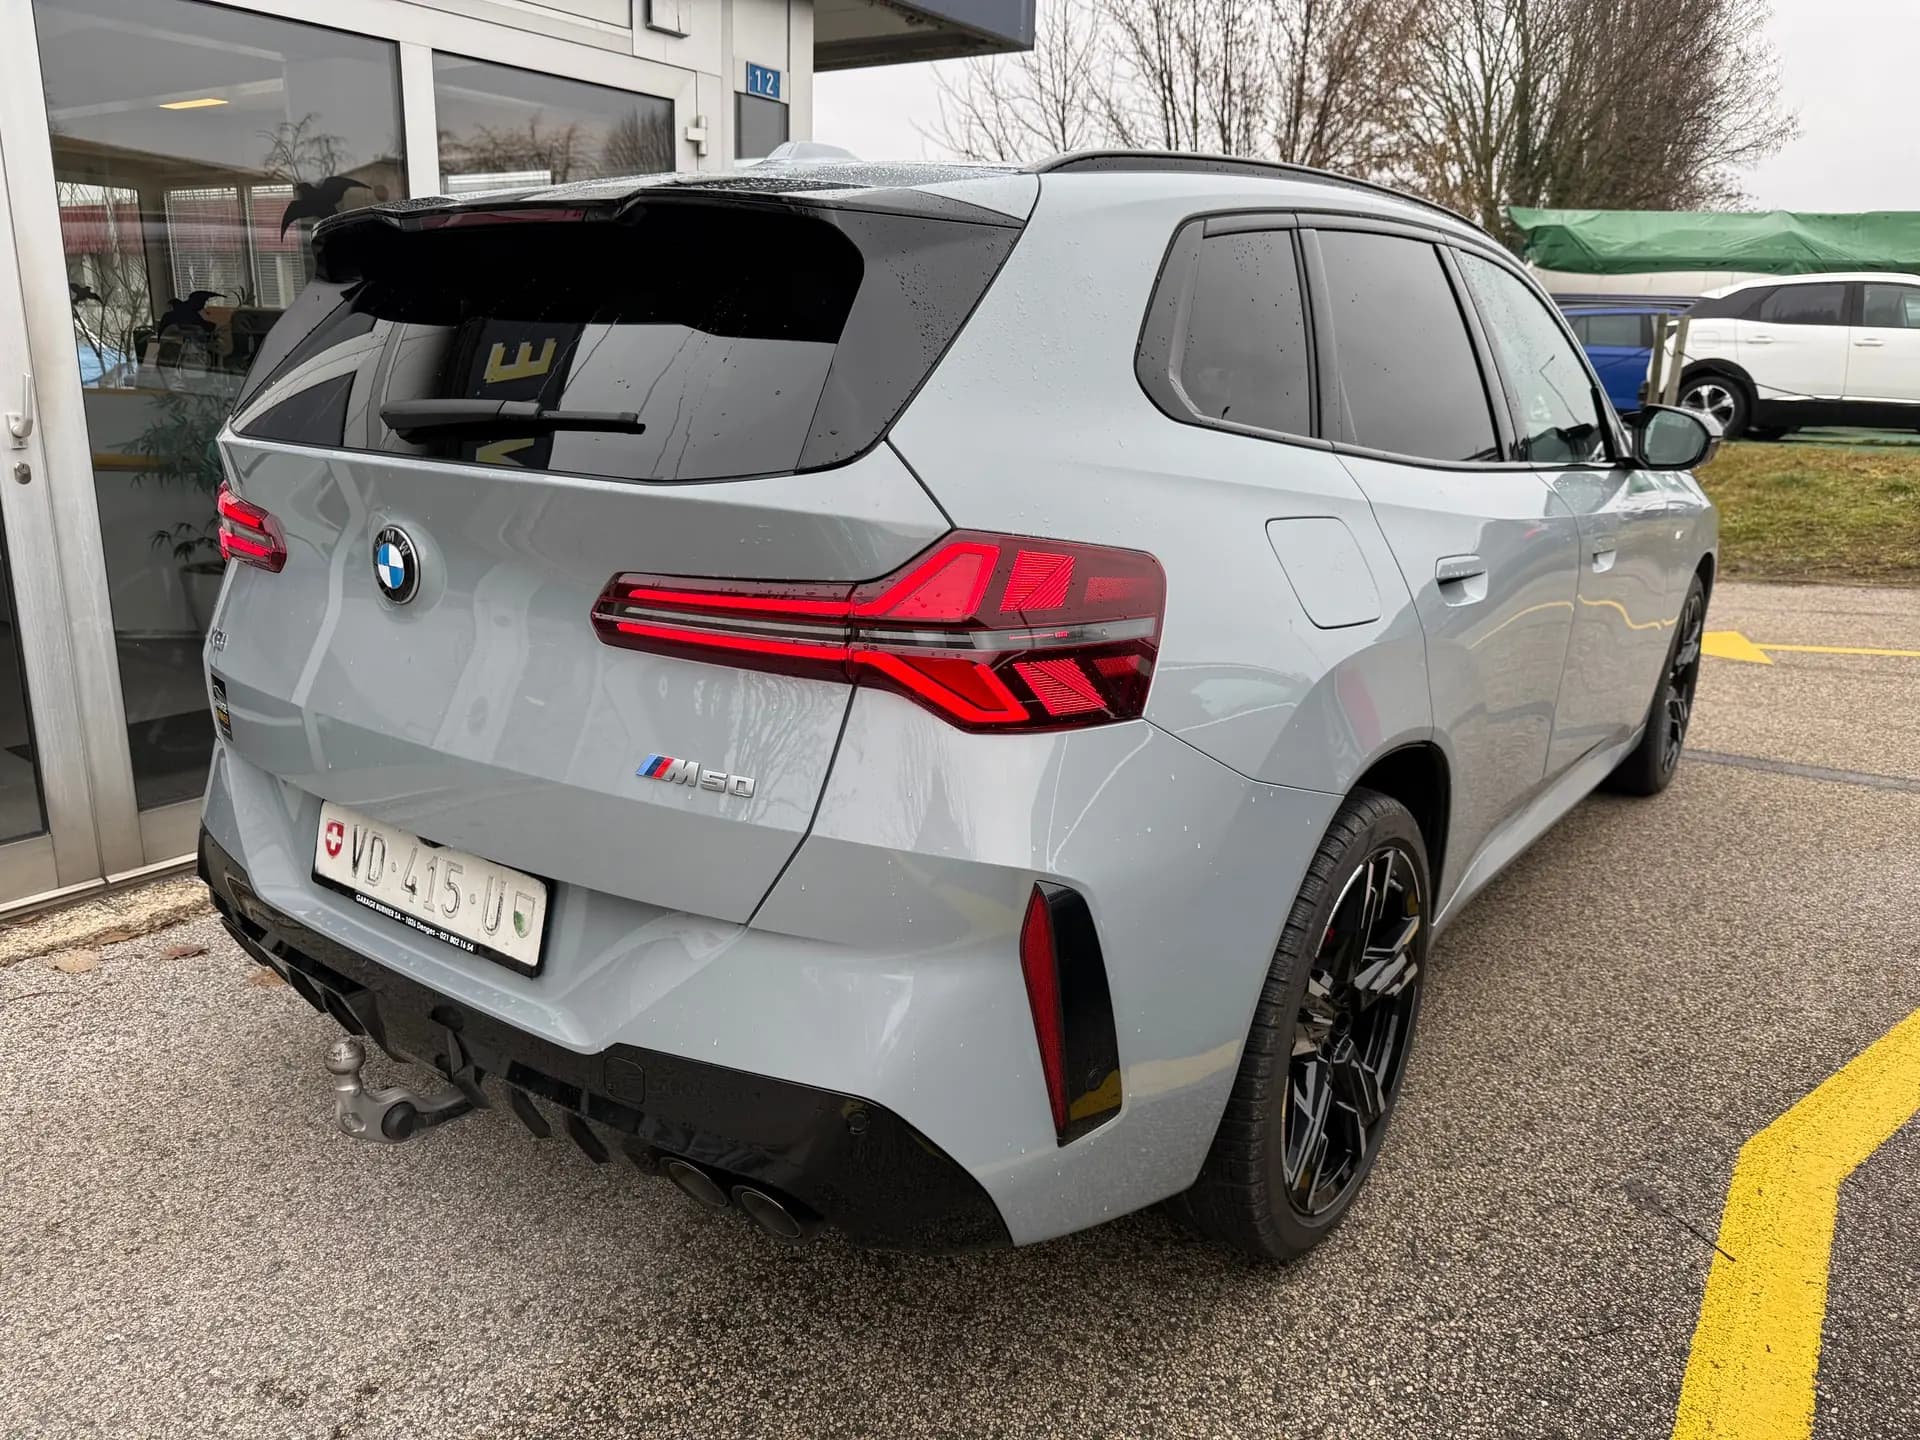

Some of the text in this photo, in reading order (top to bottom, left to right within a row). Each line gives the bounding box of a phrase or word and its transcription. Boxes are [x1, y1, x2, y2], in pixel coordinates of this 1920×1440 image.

[755, 70, 774, 94] 12
[661, 757, 756, 799] M50
[355, 894, 376, 909] GARAGE
[416, 921, 436, 936] Denges
[440, 931, 449, 941] 021
